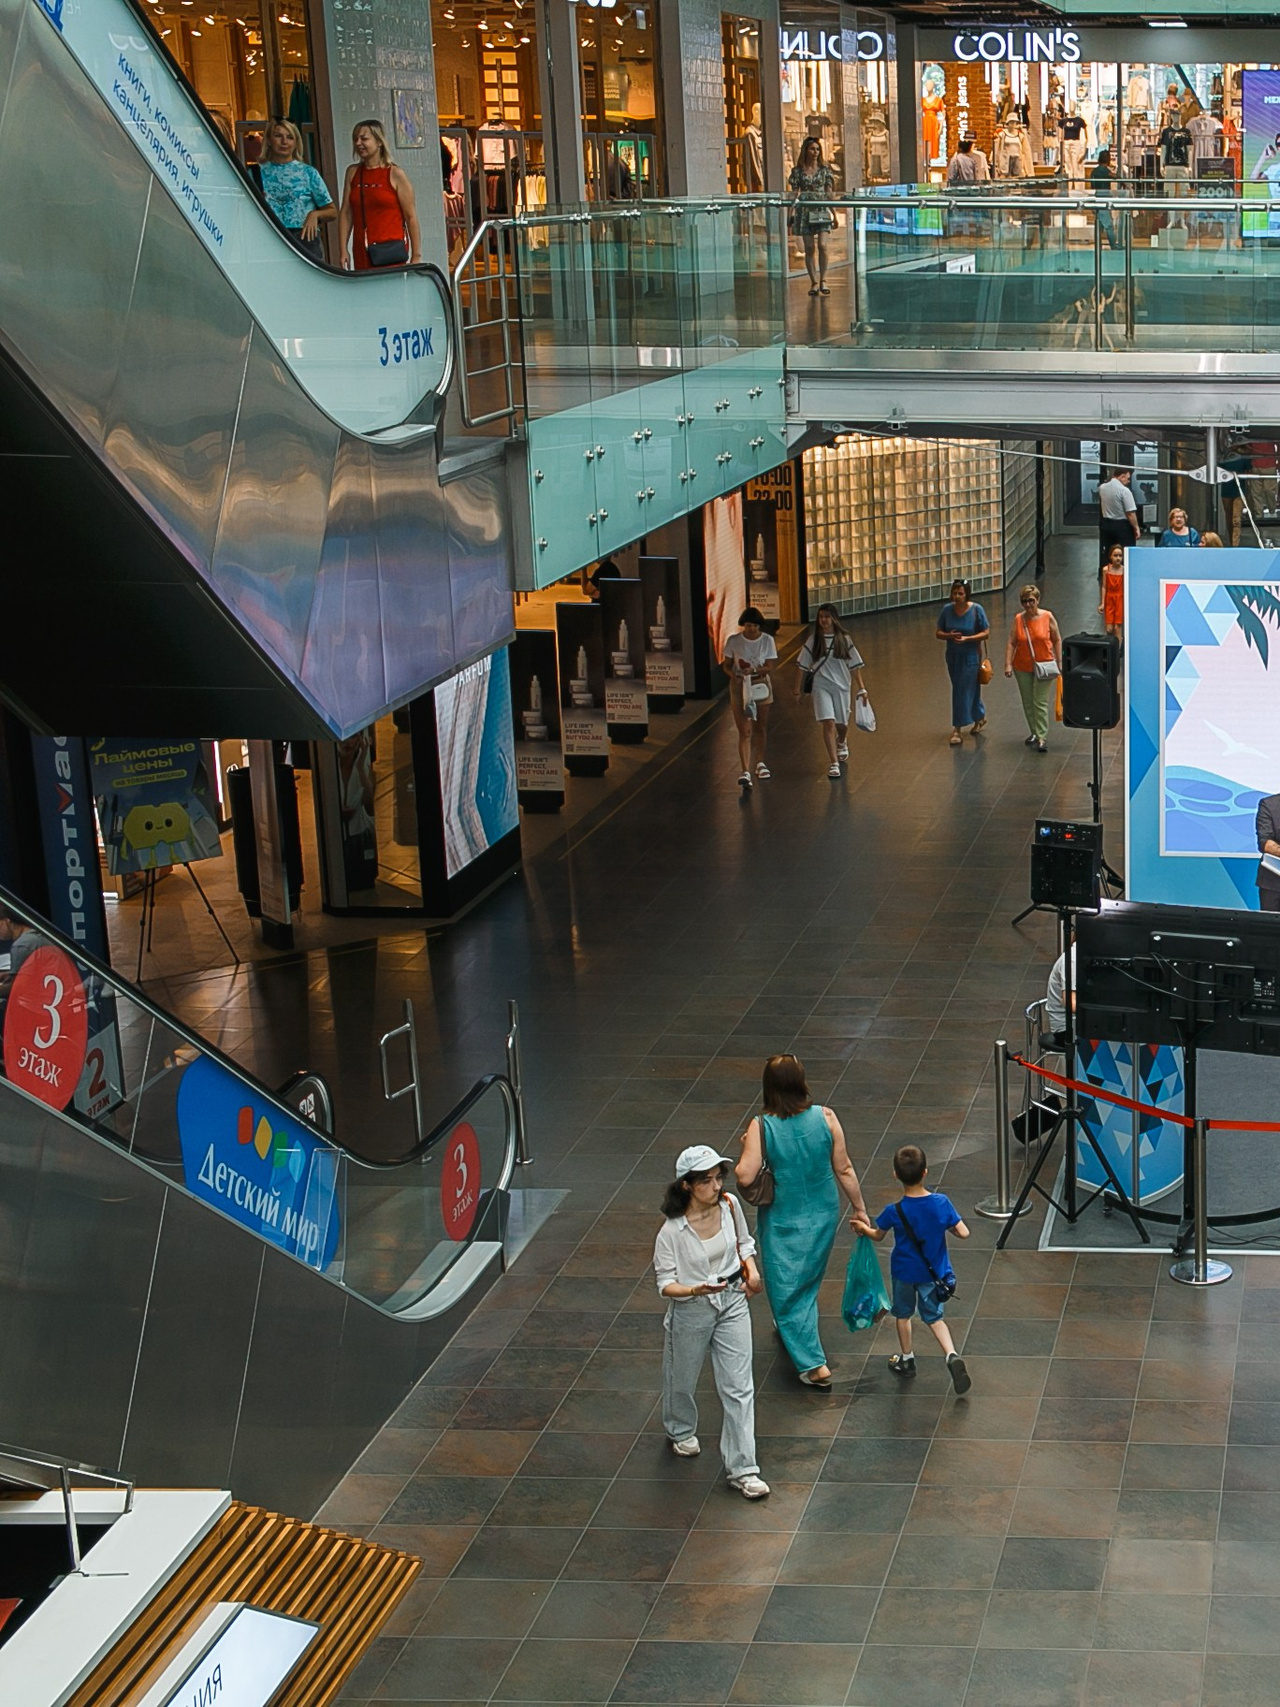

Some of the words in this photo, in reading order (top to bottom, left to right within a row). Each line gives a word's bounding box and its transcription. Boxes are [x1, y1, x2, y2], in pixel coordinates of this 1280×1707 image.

[954, 28, 1080, 61] COLIN'S
[117, 52, 152, 114] книги,
[154, 107, 200, 181] комиксы
[112, 79, 180, 187] канцелярия,
[181, 179, 224, 247] игрушки
[378, 327, 389, 367] 3
[392, 327, 434, 363] этаж
[94, 742, 196, 765] Лаймовые
[122, 758, 173, 773] цены
[33, 975, 64, 1049] 3
[17, 1047, 62, 1088] этаж
[86, 1048, 107, 1099] 2
[452, 1142, 468, 1199] 3
[197, 1143, 280, 1228] Детский
[281, 1207, 318, 1261] мир
